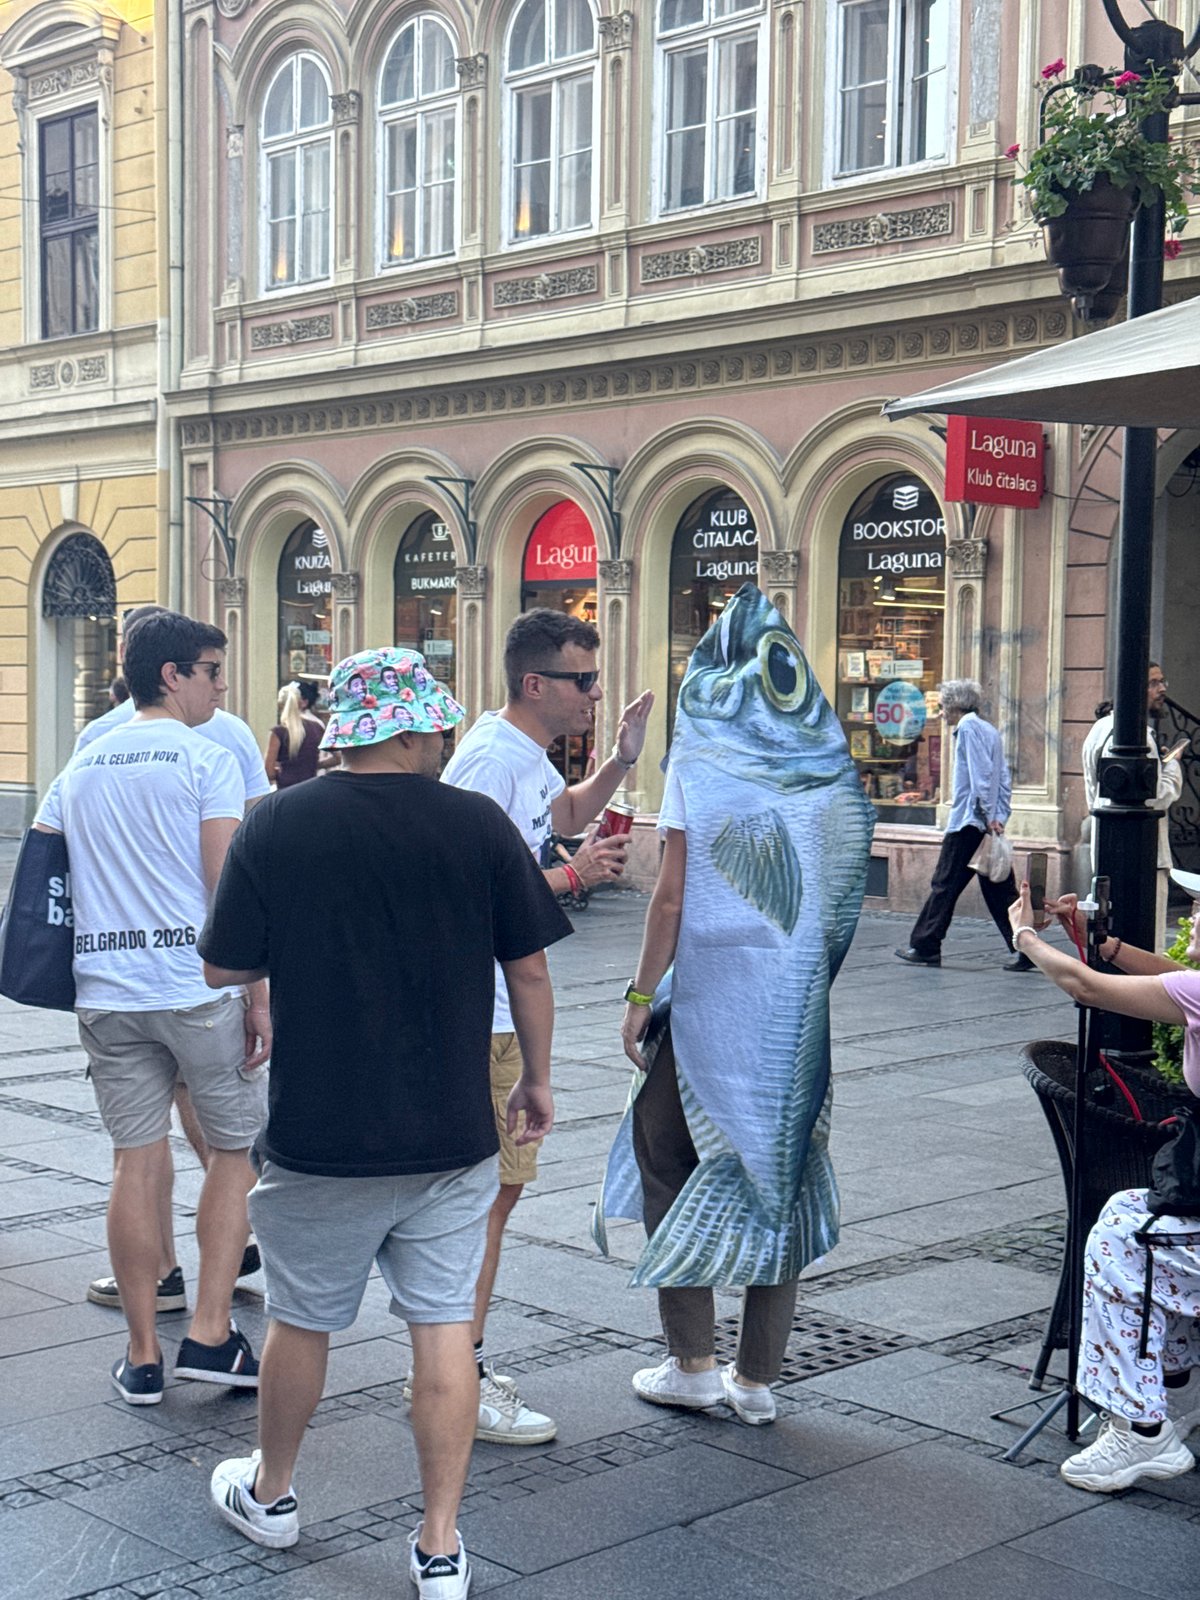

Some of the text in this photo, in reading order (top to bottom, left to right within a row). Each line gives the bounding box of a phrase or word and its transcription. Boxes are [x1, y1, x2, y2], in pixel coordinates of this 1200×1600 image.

[971, 430, 1036, 459] Laguna
[967, 467, 1037, 492] Klub čitalaca
[710, 509, 748, 527] KLUB
[696, 560, 759, 581] Laguna
[868, 552, 942, 574] Laguna
[411, 576, 458, 591] BUKMARK
[94, 754, 106, 766] AL
[109, 751, 151, 765] CELIBATO
[152, 750, 179, 764] NOVA
[76, 926, 196, 955] BELGRADO 2026
